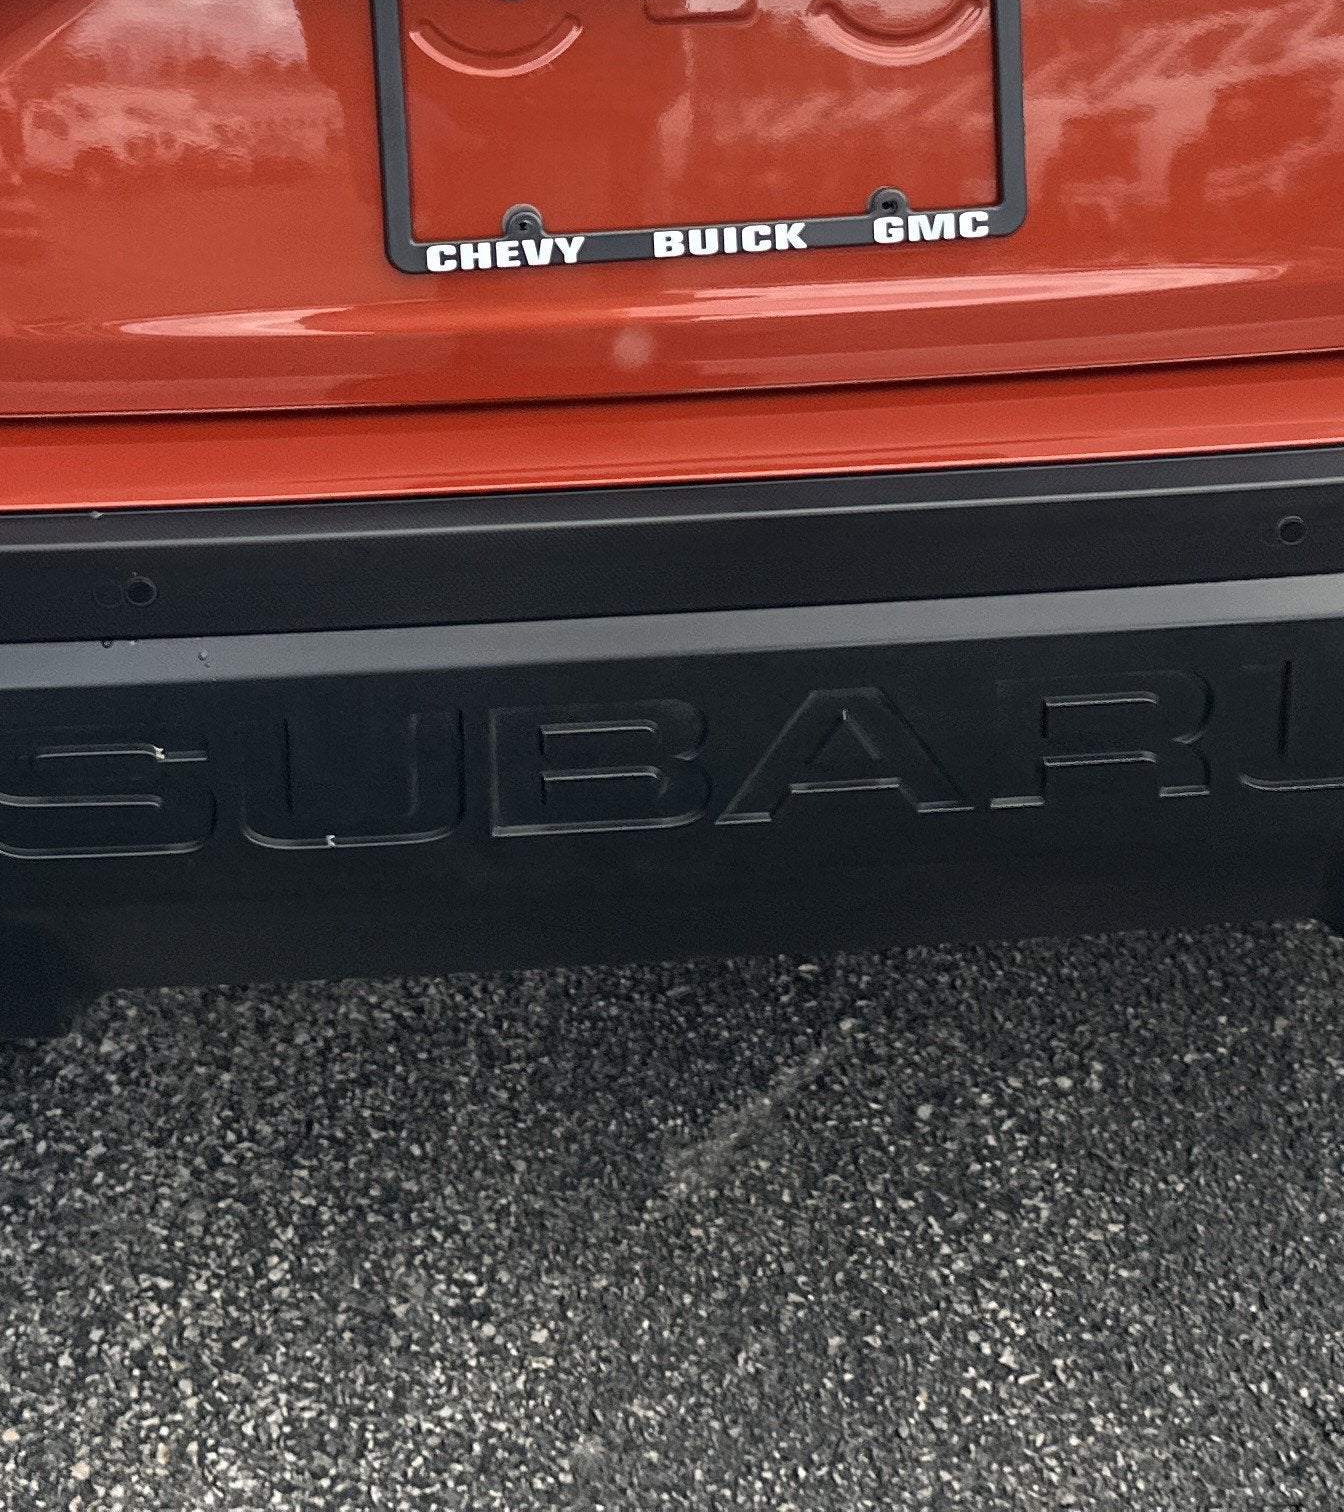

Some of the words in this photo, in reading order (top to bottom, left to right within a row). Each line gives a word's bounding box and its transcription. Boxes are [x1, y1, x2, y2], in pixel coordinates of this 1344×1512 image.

[425, 235, 586, 273] CHEVY
[652, 221, 808, 258] BUICK
[872, 209, 990, 245] GMC
